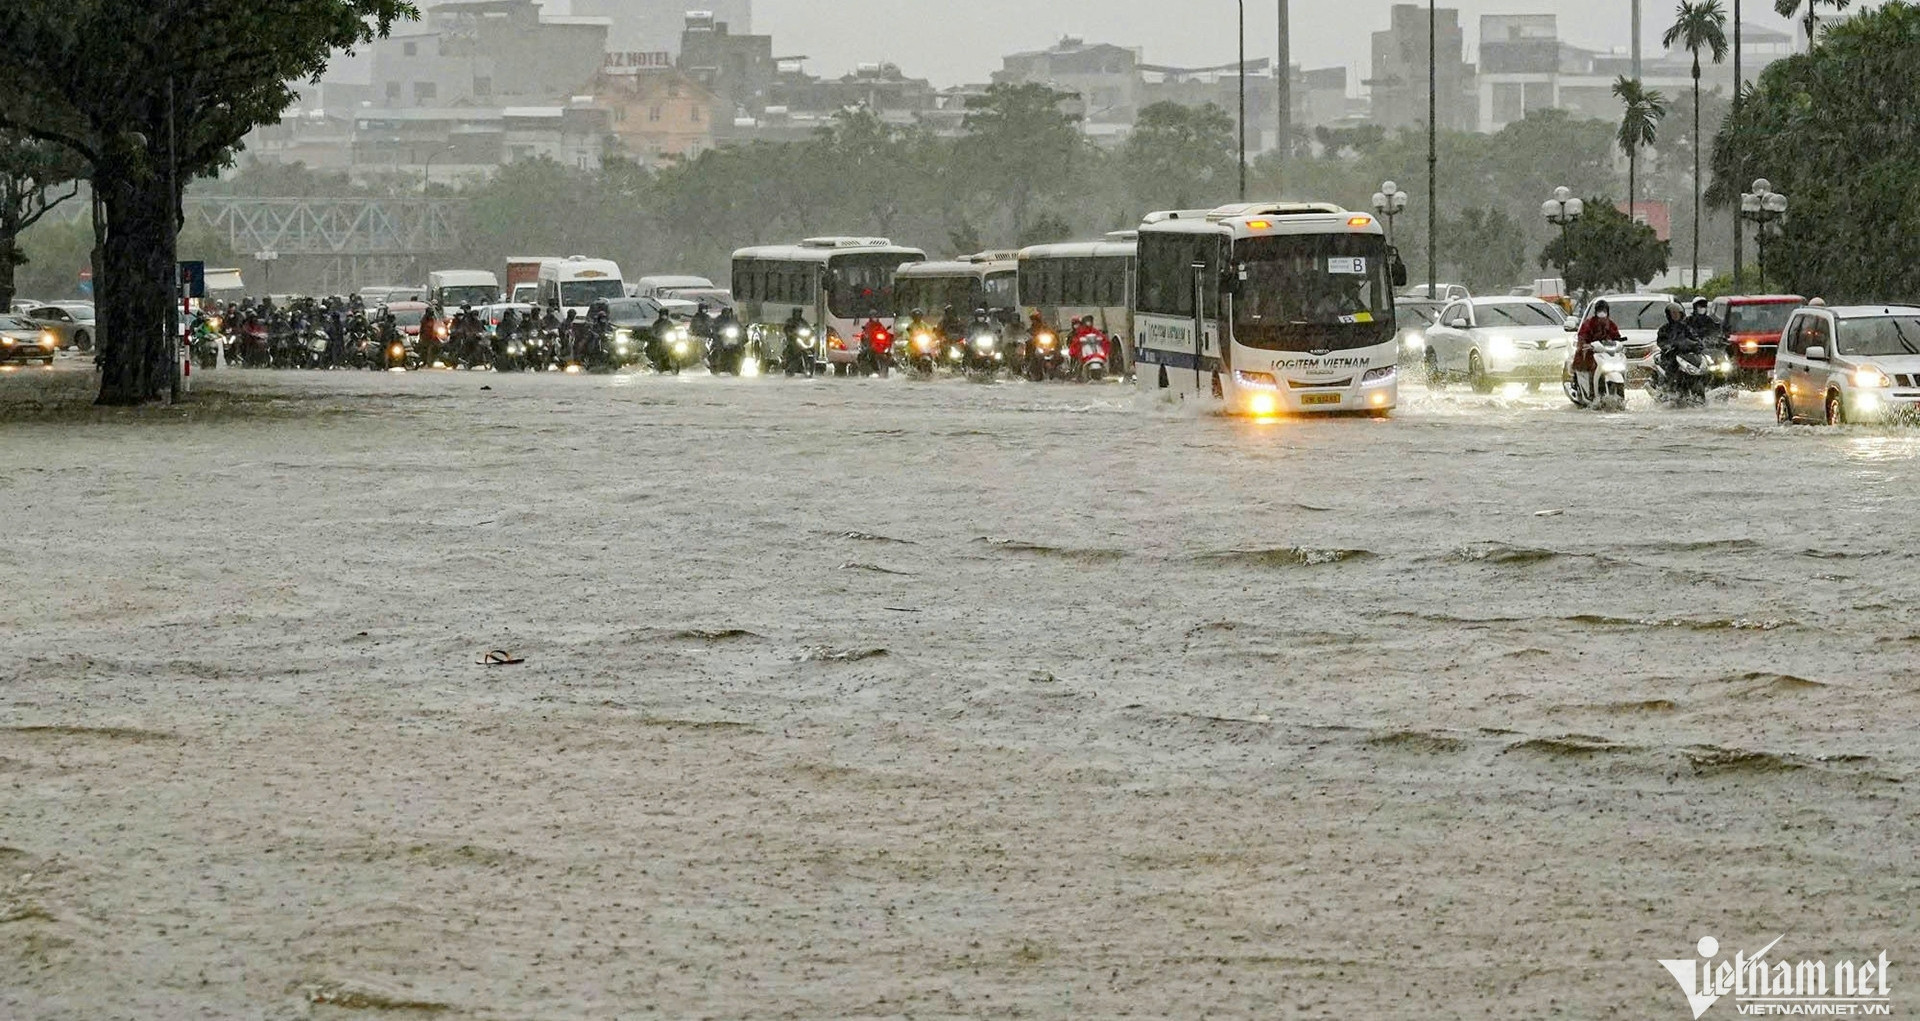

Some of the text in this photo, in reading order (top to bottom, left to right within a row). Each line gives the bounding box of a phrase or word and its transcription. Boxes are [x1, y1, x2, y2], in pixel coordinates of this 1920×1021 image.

[604, 52, 669, 66] AZ HOTEL
[1353, 258, 1363, 272] B
[1271, 357, 1370, 370] LOGITEM VIETNAM
